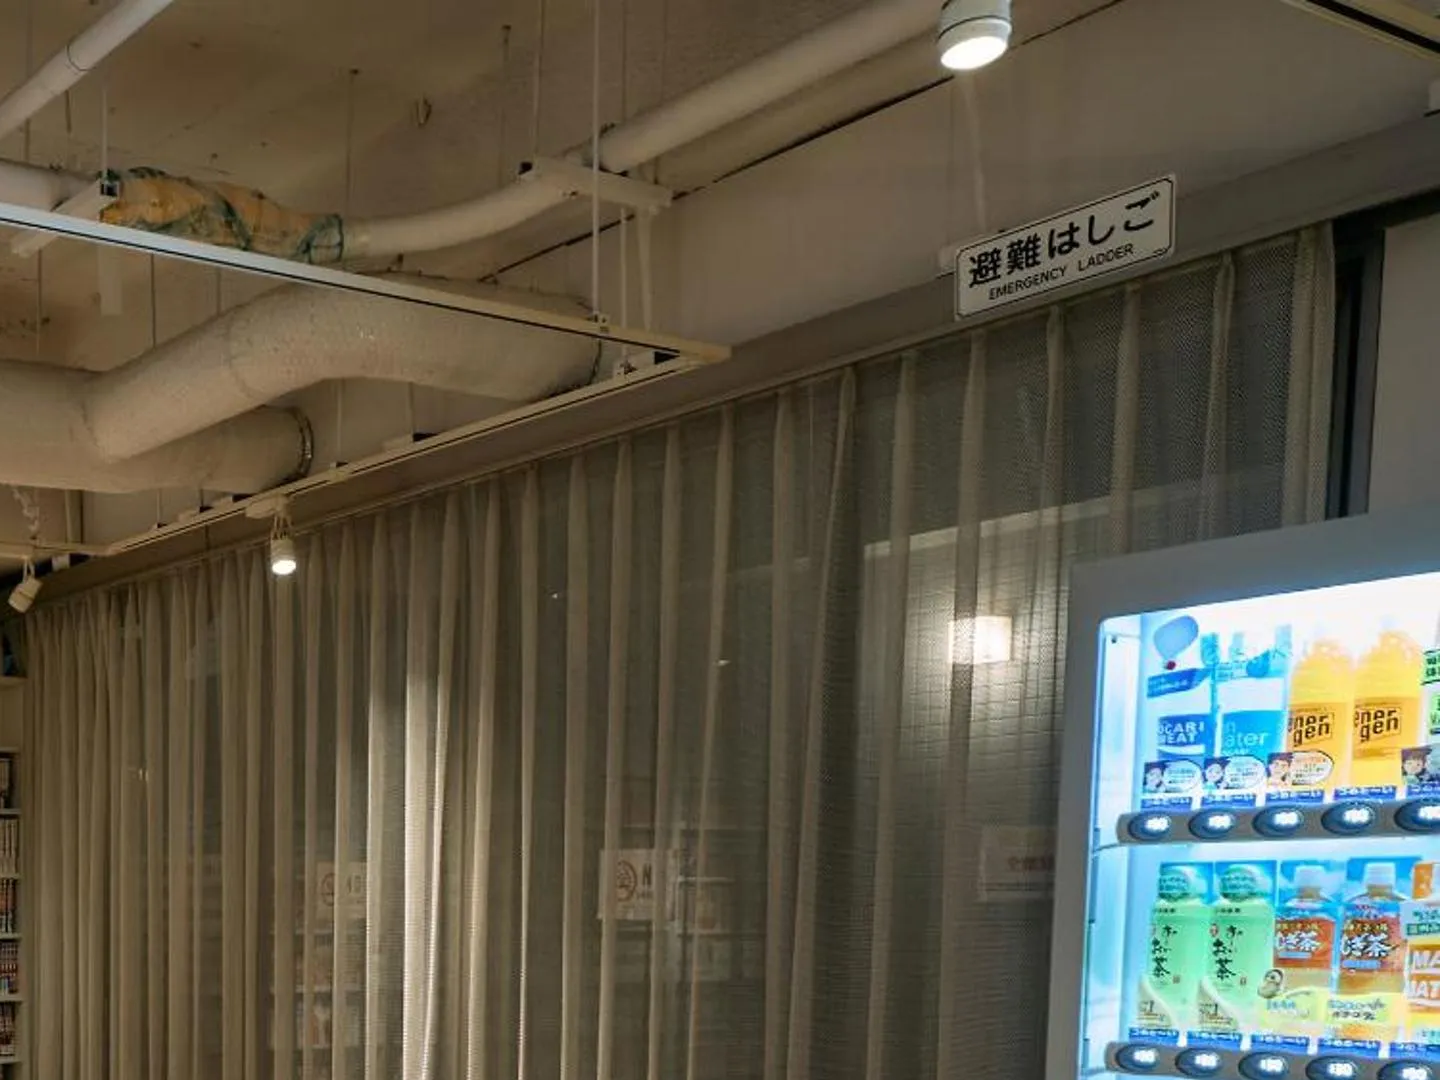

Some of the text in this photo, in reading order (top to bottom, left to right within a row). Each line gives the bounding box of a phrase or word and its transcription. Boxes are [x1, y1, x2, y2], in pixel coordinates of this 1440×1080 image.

[968, 189, 1160, 288] 避難はしご
[988, 242, 1135, 300] EMERGENCY LADDER
[1293, 722, 1330, 747] gen
[1360, 716, 1399, 742] gen
